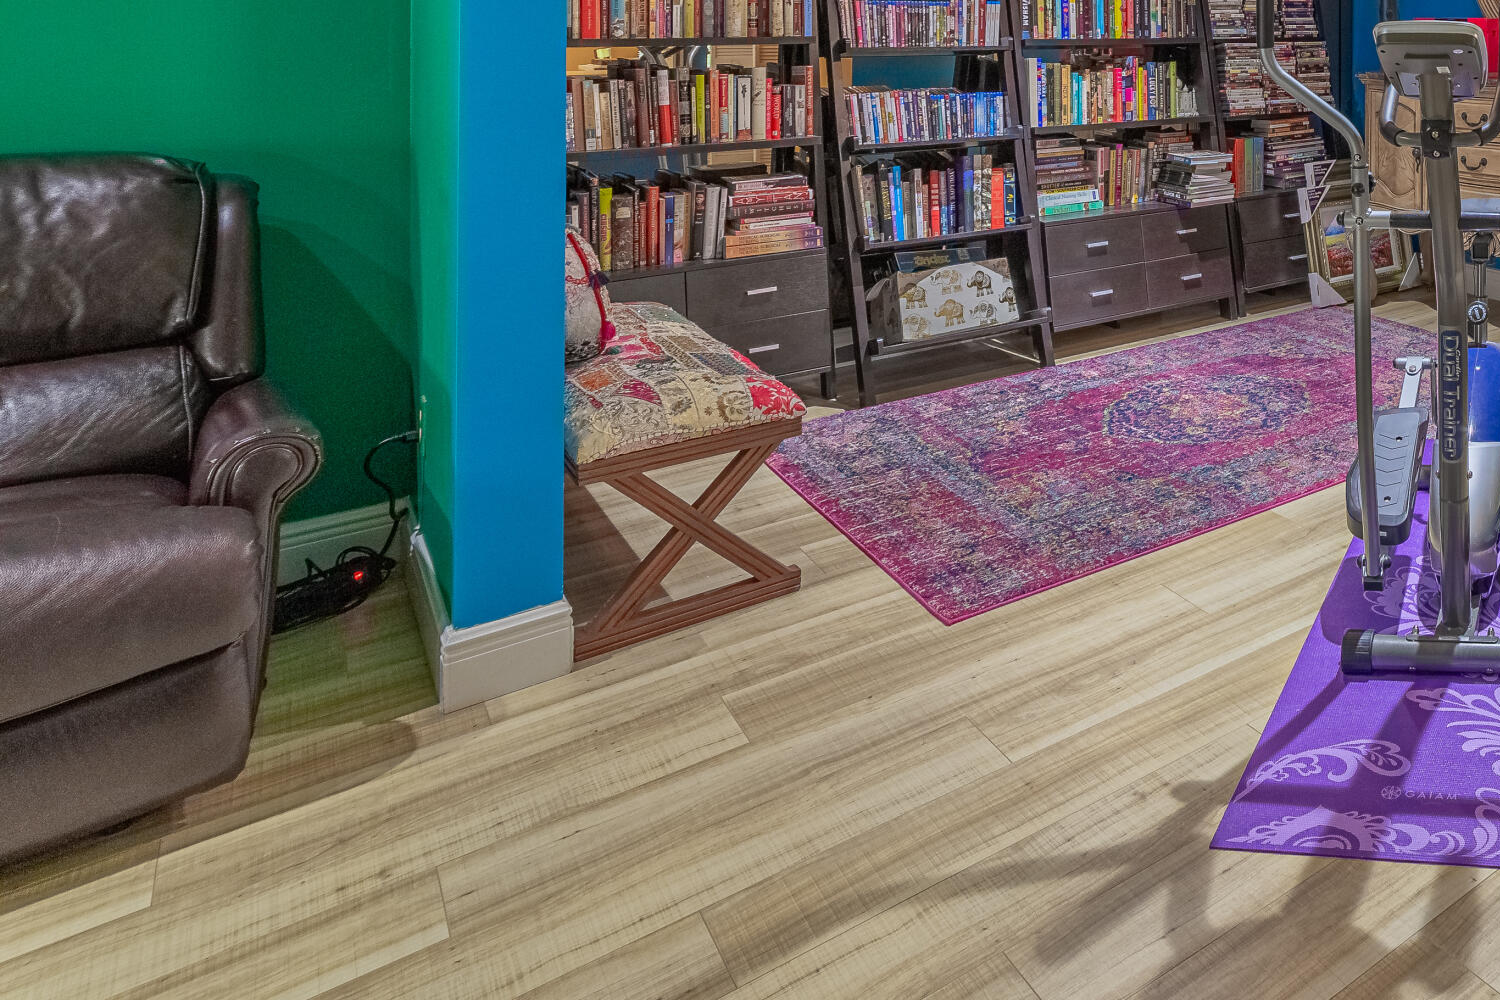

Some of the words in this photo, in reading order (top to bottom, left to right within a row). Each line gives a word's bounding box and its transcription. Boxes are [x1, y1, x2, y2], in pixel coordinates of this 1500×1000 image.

[771, 95, 780, 119] WORLD
[1442, 335, 1459, 382] Dual
[1442, 385, 1460, 458] Trainer
